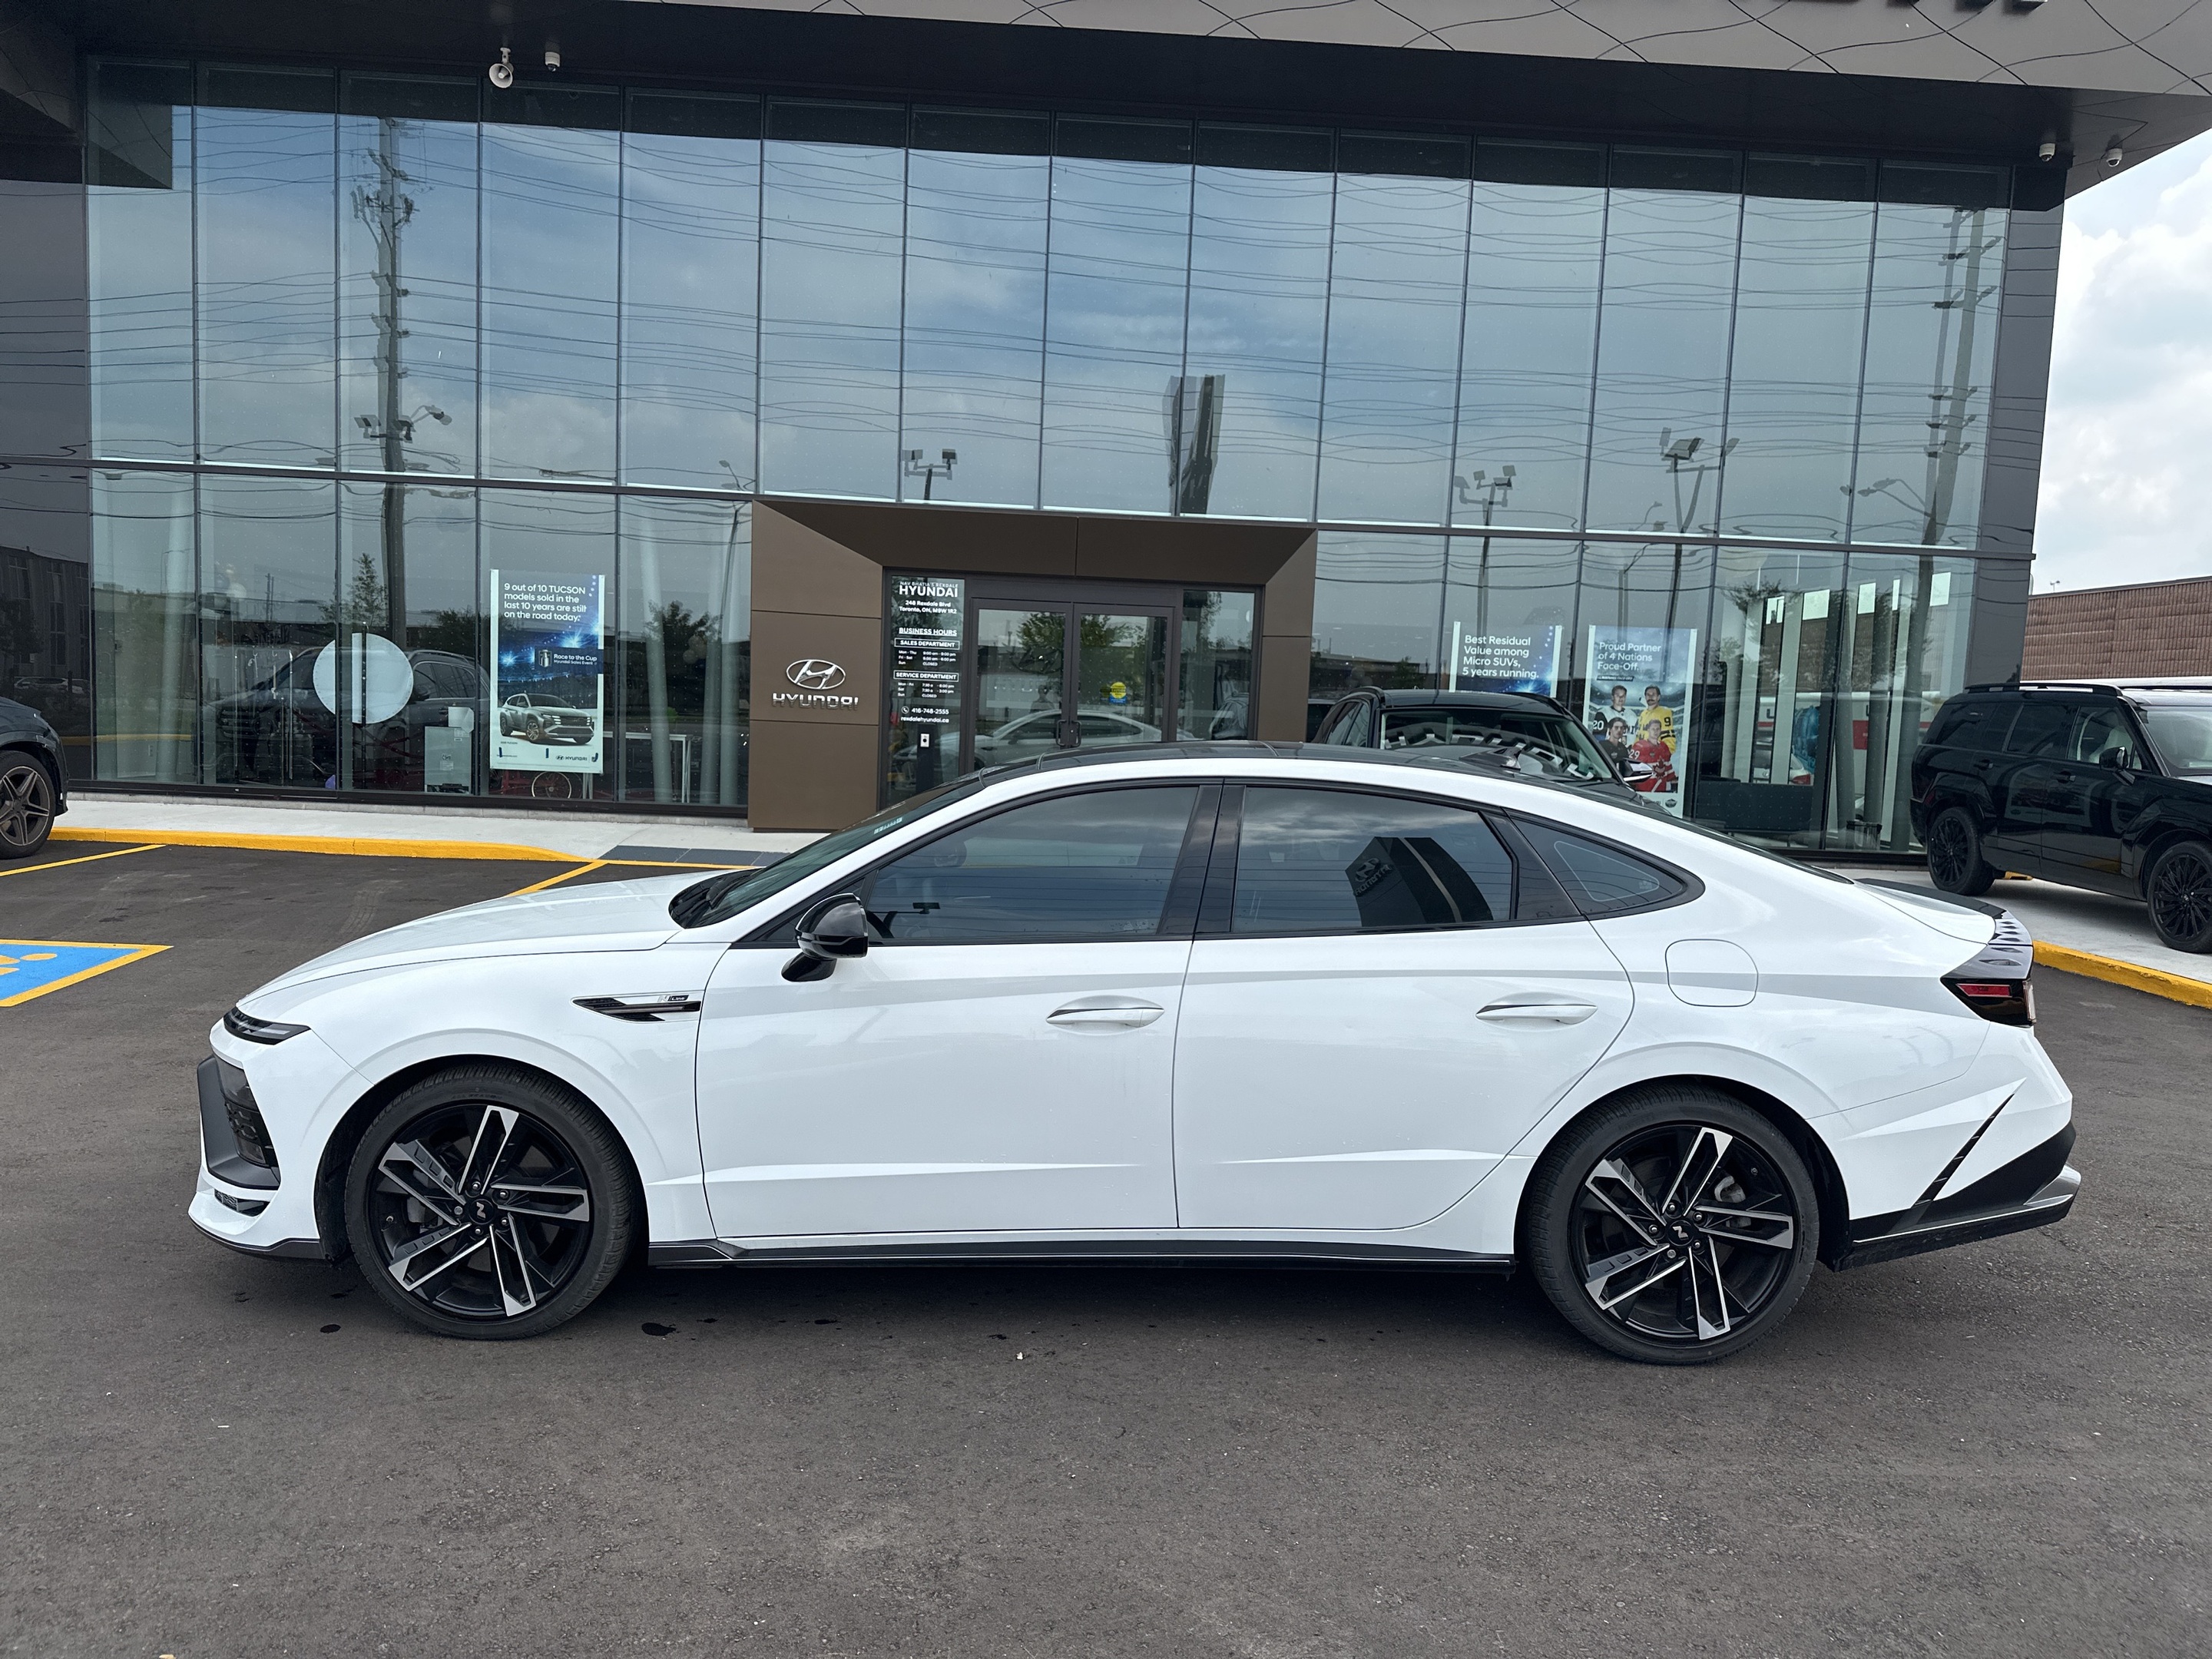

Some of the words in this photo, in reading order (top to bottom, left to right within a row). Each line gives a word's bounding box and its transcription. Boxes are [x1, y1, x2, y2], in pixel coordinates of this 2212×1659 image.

[549, 585, 585, 594] TUCSON
[899, 585, 958, 598] HYUNDAI
[1465, 635, 1486, 644] Best
[1489, 636, 1531, 645] Residual
[1599, 642, 1625, 651] Proud
[1628, 643, 1661, 651] Partner
[1464, 646, 1492, 654] Value
[1494, 648, 1529, 658] among
[1618, 653, 1652, 661] Nations
[1463, 656, 1491, 665] Micro
[1492, 657, 1521, 667] SUVs,
[1598, 662, 1639, 671] Face-Off.
[1462, 667, 1469, 675] 5
[1471, 669, 1497, 677] years
[1499, 668, 1539, 680] running.
[773, 693, 859, 710] HYUNDAI
[1593, 720, 1604, 730] 20
[1664, 717, 1671, 727] 9
[1629, 750, 1640, 760] 29
